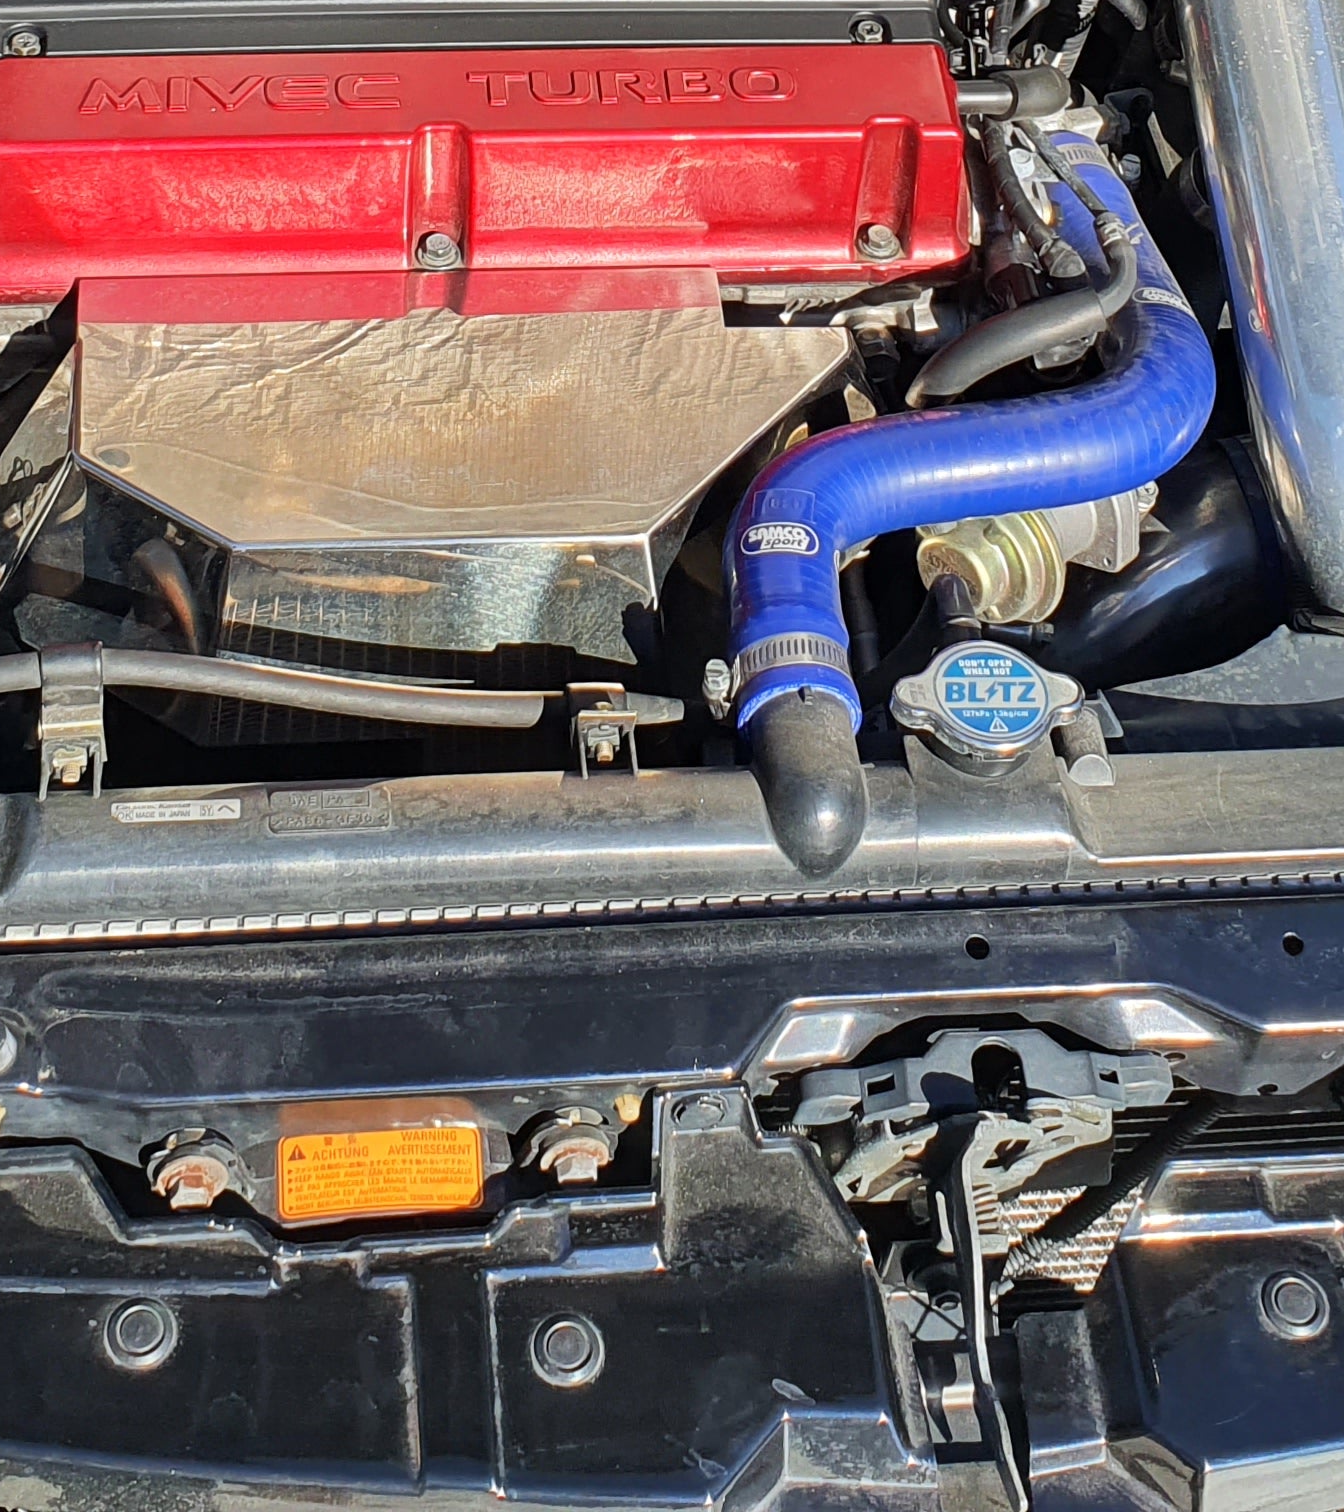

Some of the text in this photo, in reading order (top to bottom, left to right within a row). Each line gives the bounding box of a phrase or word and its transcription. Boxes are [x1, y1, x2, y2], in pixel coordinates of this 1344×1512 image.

[79, 67, 799, 115] MIVEC TURBO
[764, 537, 803, 549] sport
[958, 659, 1012, 667] DON'T OPEN
[963, 667, 1011, 675] WHEN HOT
[945, 681, 1036, 703] BLITZ
[401, 1131, 457, 1142] WARNING
[312, 1145, 369, 1161] ACHTUNG
[388, 1144, 472, 1156] AVERTISSEMENT
